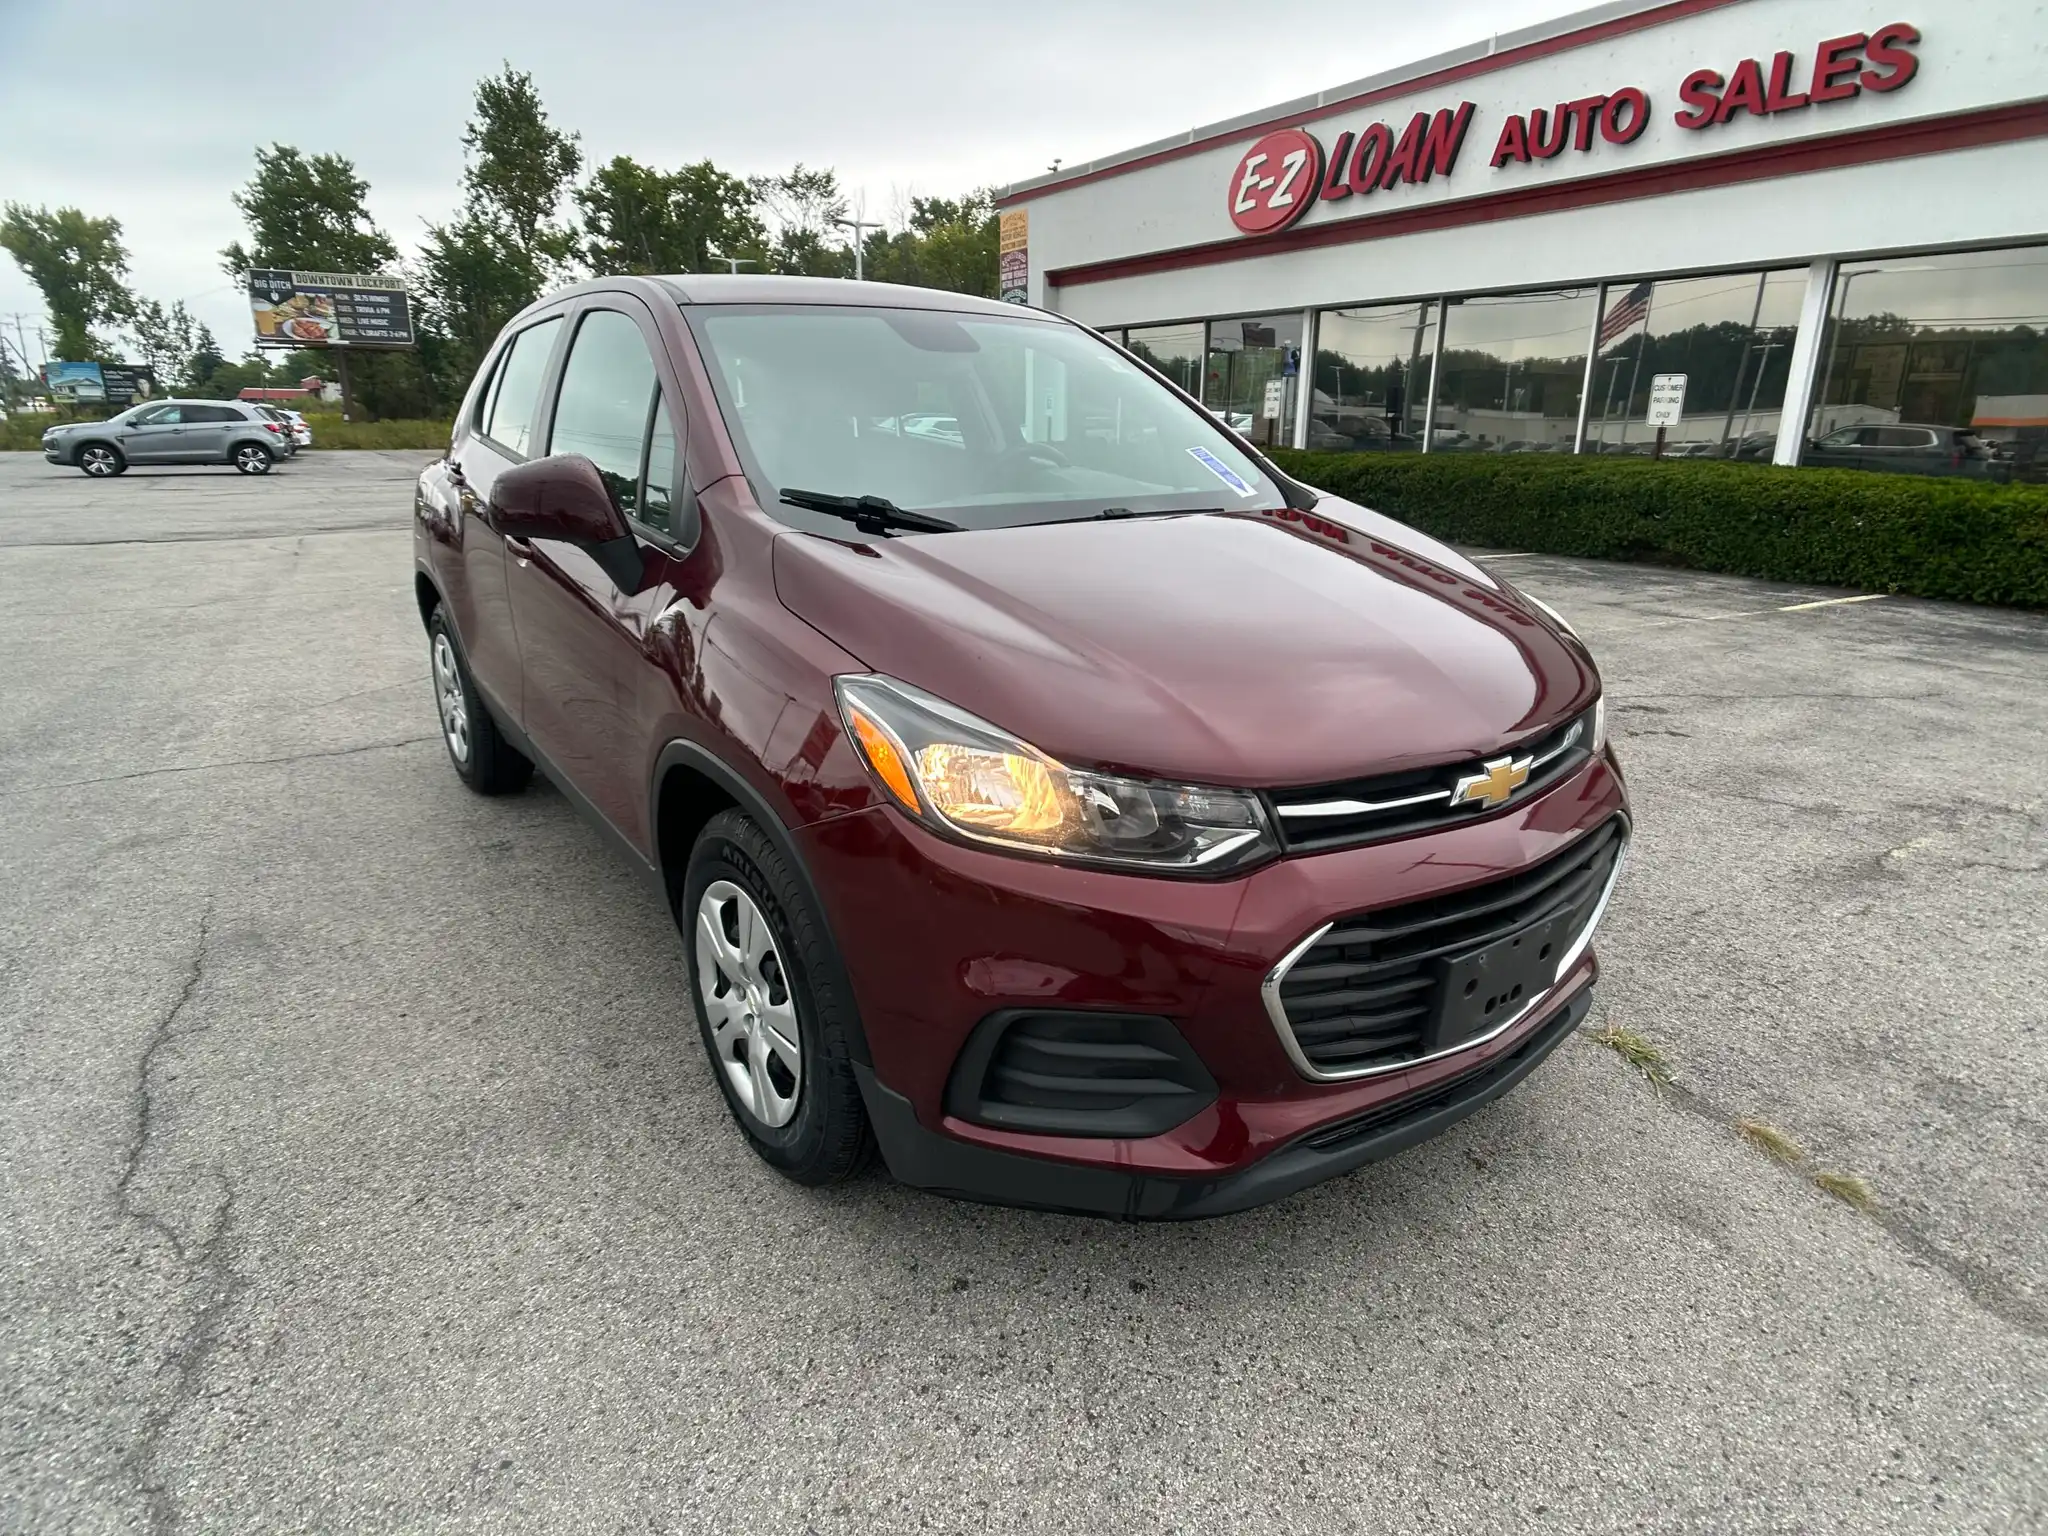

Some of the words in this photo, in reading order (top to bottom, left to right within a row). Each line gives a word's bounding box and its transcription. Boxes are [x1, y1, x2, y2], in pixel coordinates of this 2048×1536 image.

[1234, 149, 1307, 213] E-Z
[1320, 101, 1476, 202] LOAN
[1490, 86, 1651, 168] AUTO
[1675, 22, 1921, 131] SALES
[254, 279, 268, 289] BIG
[269, 280, 292, 290] DITCH
[296, 274, 354, 286] DOWNTOWN
[357, 278, 401, 289] LOCKPORT
